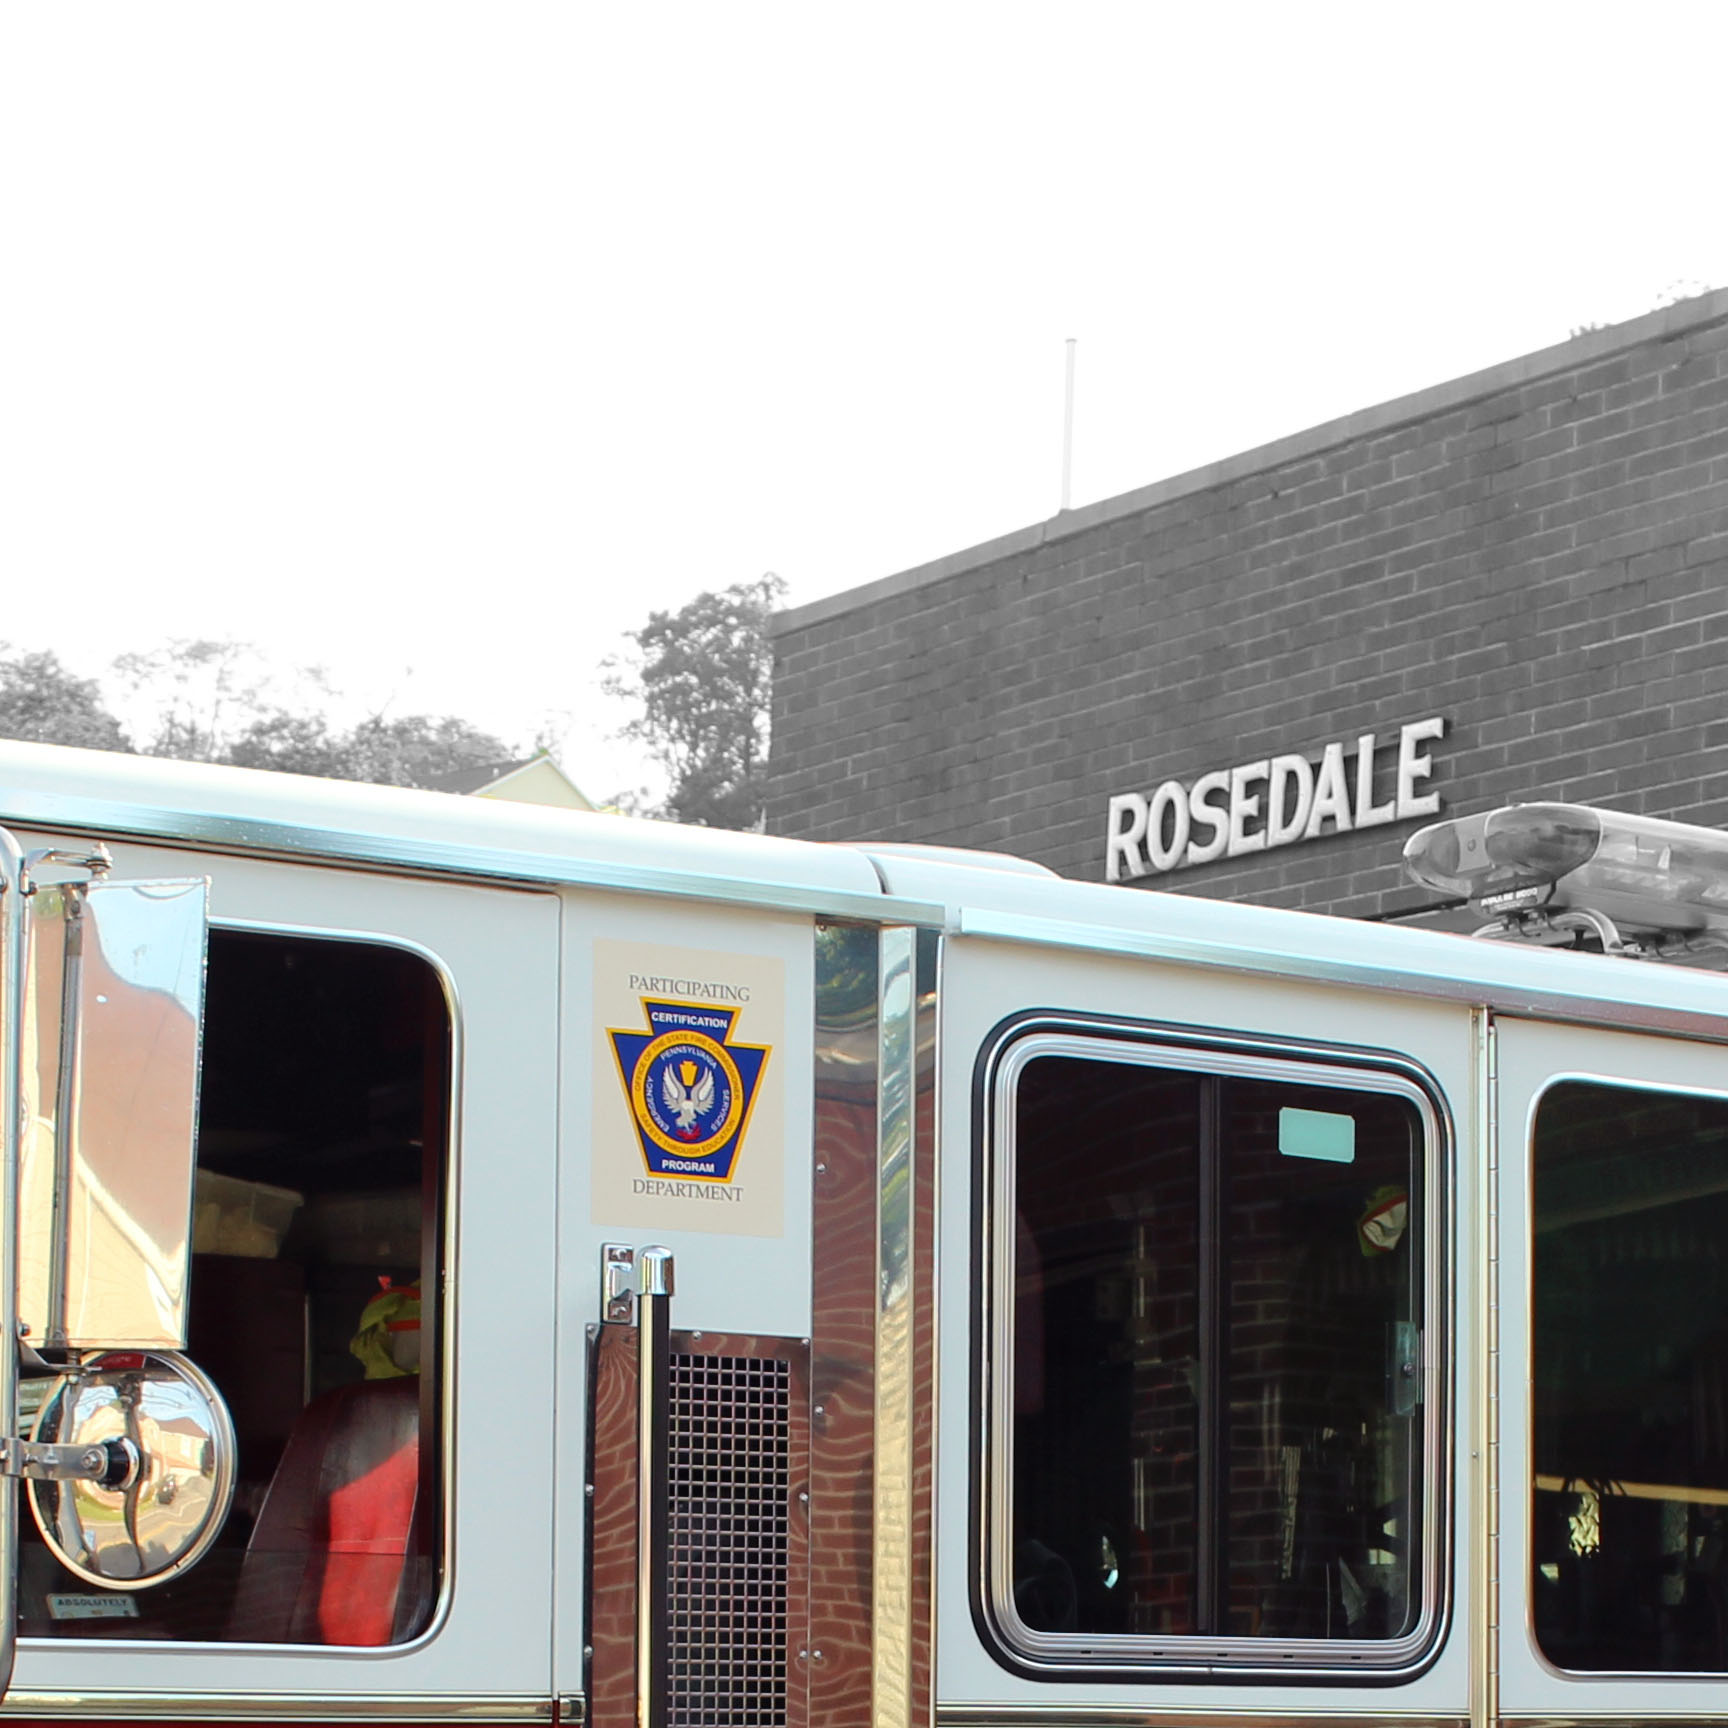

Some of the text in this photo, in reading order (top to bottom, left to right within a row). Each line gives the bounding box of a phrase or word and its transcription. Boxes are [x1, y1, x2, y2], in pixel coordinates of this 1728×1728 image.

[1105, 717, 1444, 882] ROSEDALE
[628, 974, 751, 1001] PARTICIPATING
[650, 1011, 728, 1029] CERTIFICATION
[659, 1045, 718, 1070] PENNSYLVANIA
[661, 1159, 716, 1174] PROGRAM
[632, 1178, 744, 1202] DEPARTMENT
[57, 1598, 129, 1607] ABSOLUTELY
